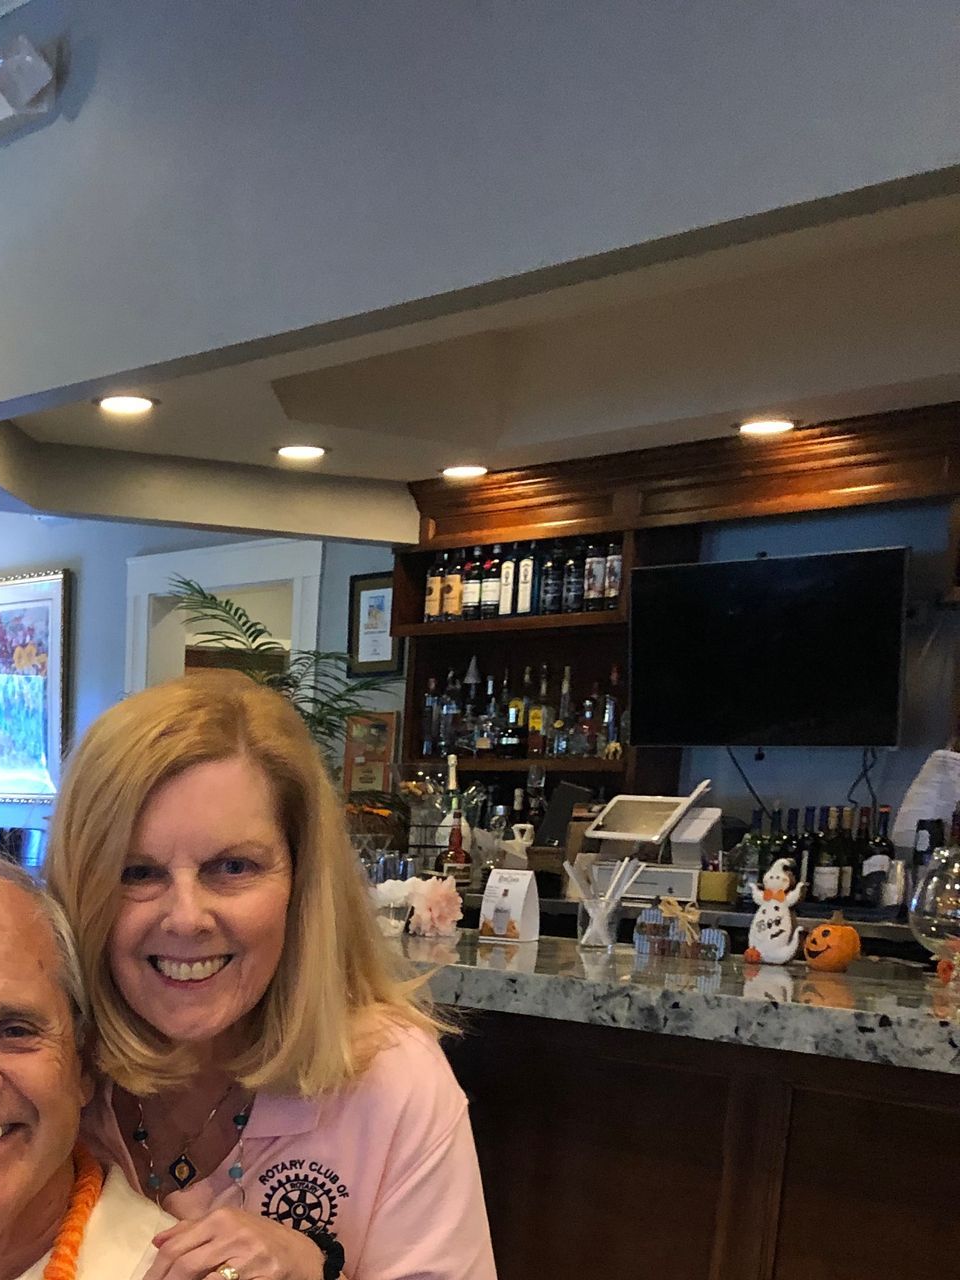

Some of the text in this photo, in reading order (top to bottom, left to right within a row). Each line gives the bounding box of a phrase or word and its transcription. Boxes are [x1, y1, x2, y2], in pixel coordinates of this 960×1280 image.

[258, 1159, 350, 1198] ROTARY CLUB OF
[289, 1182, 319, 1193] ROTARY
